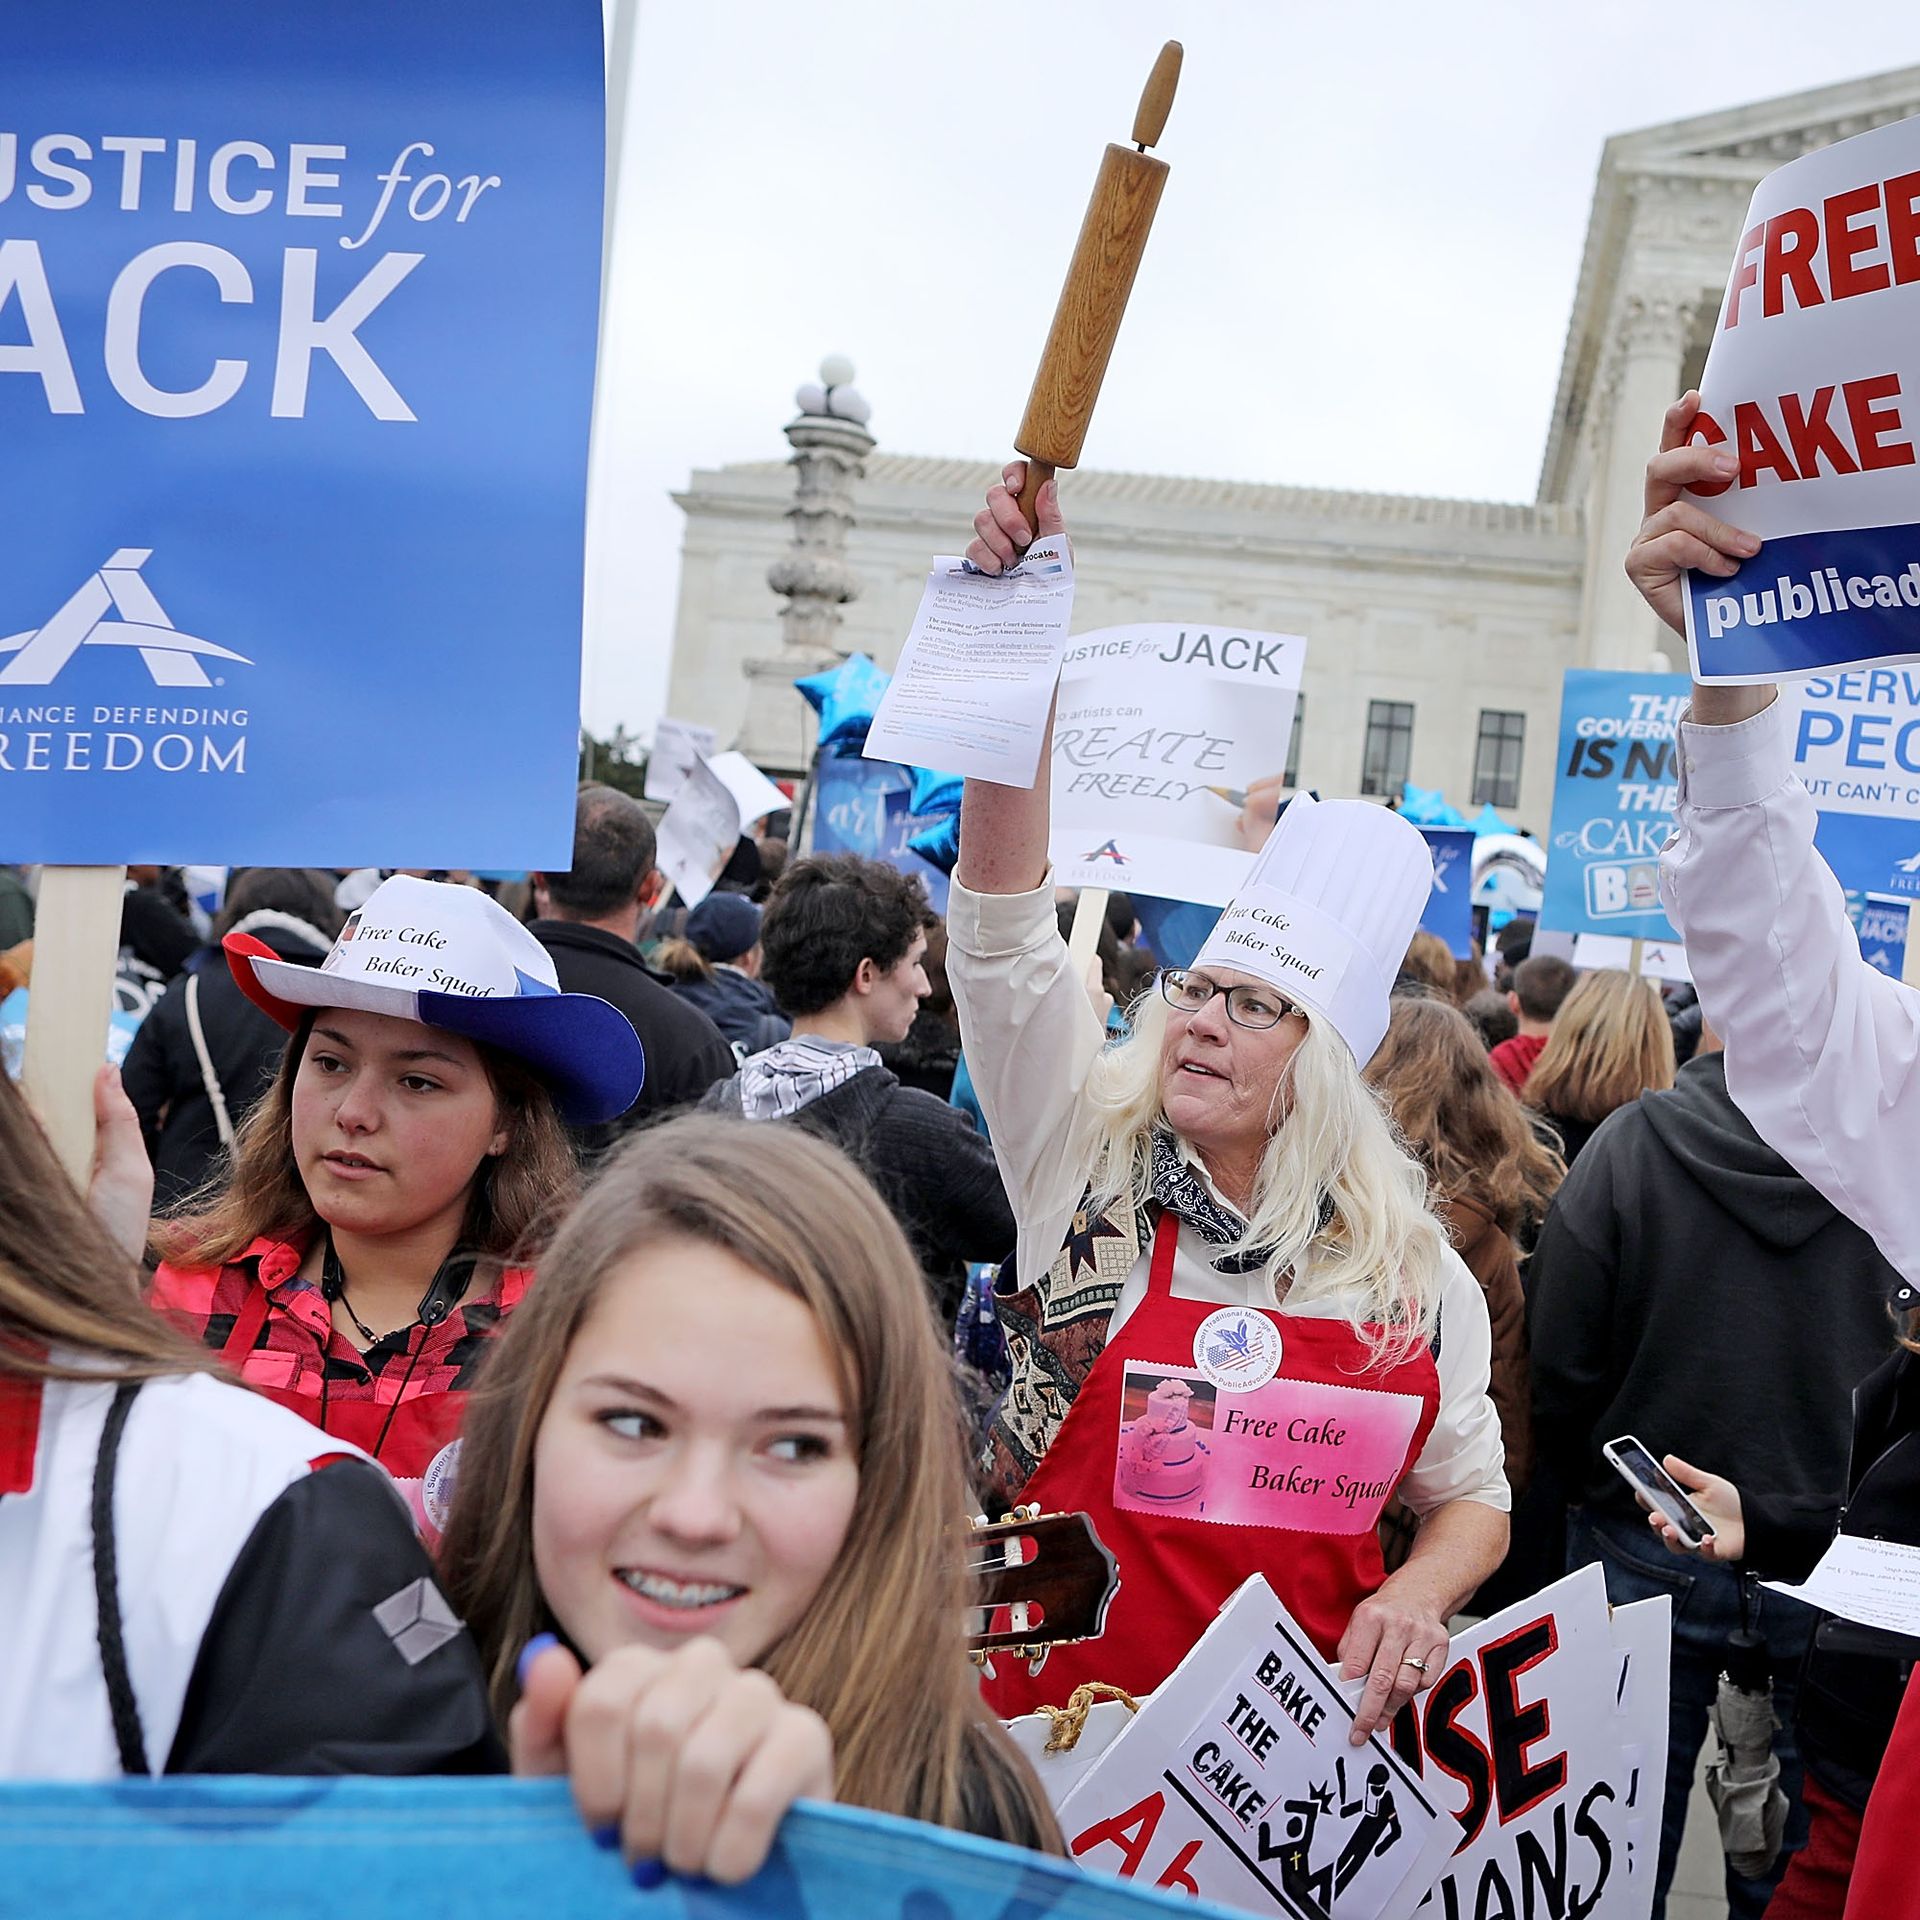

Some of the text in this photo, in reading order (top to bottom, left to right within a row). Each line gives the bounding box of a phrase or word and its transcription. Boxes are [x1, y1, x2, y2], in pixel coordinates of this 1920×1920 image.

[0, 133, 501, 249] STICE for
[0, 240, 426, 422] ACK
[1128, 639, 1160, 660] for
[1159, 632, 1285, 676] JACK
[93, 706, 249, 727] DEFENDING
[1070, 706, 1112, 720] artists
[1116, 706, 1143, 718] can
[1629, 694, 1687, 720] TH
[1567, 739, 1678, 779] IS N
[1067, 772, 1204, 801] FREELY
[1837, 782, 1901, 802] CAN'T
[357, 926, 448, 950] Free Cake
[1251, 908, 1291, 931] Cake
[1225, 930, 1325, 980] Baker Squad
[364, 956, 495, 997] Baker Squad
[1198, 1328, 1209, 1358] Support
[1206, 1310, 1243, 1328] Traditional
[1244, 1311, 1272, 1333] Marriage
[1223, 1409, 1347, 1447] Free Cake
[428, 1453, 450, 1489] Support
[1248, 1464, 1398, 1510] Baker Squad
[1255, 1650, 1327, 1740] BAKE
[1226, 1693, 1280, 1762] THE
[1389, 1613, 1567, 1857] SE
